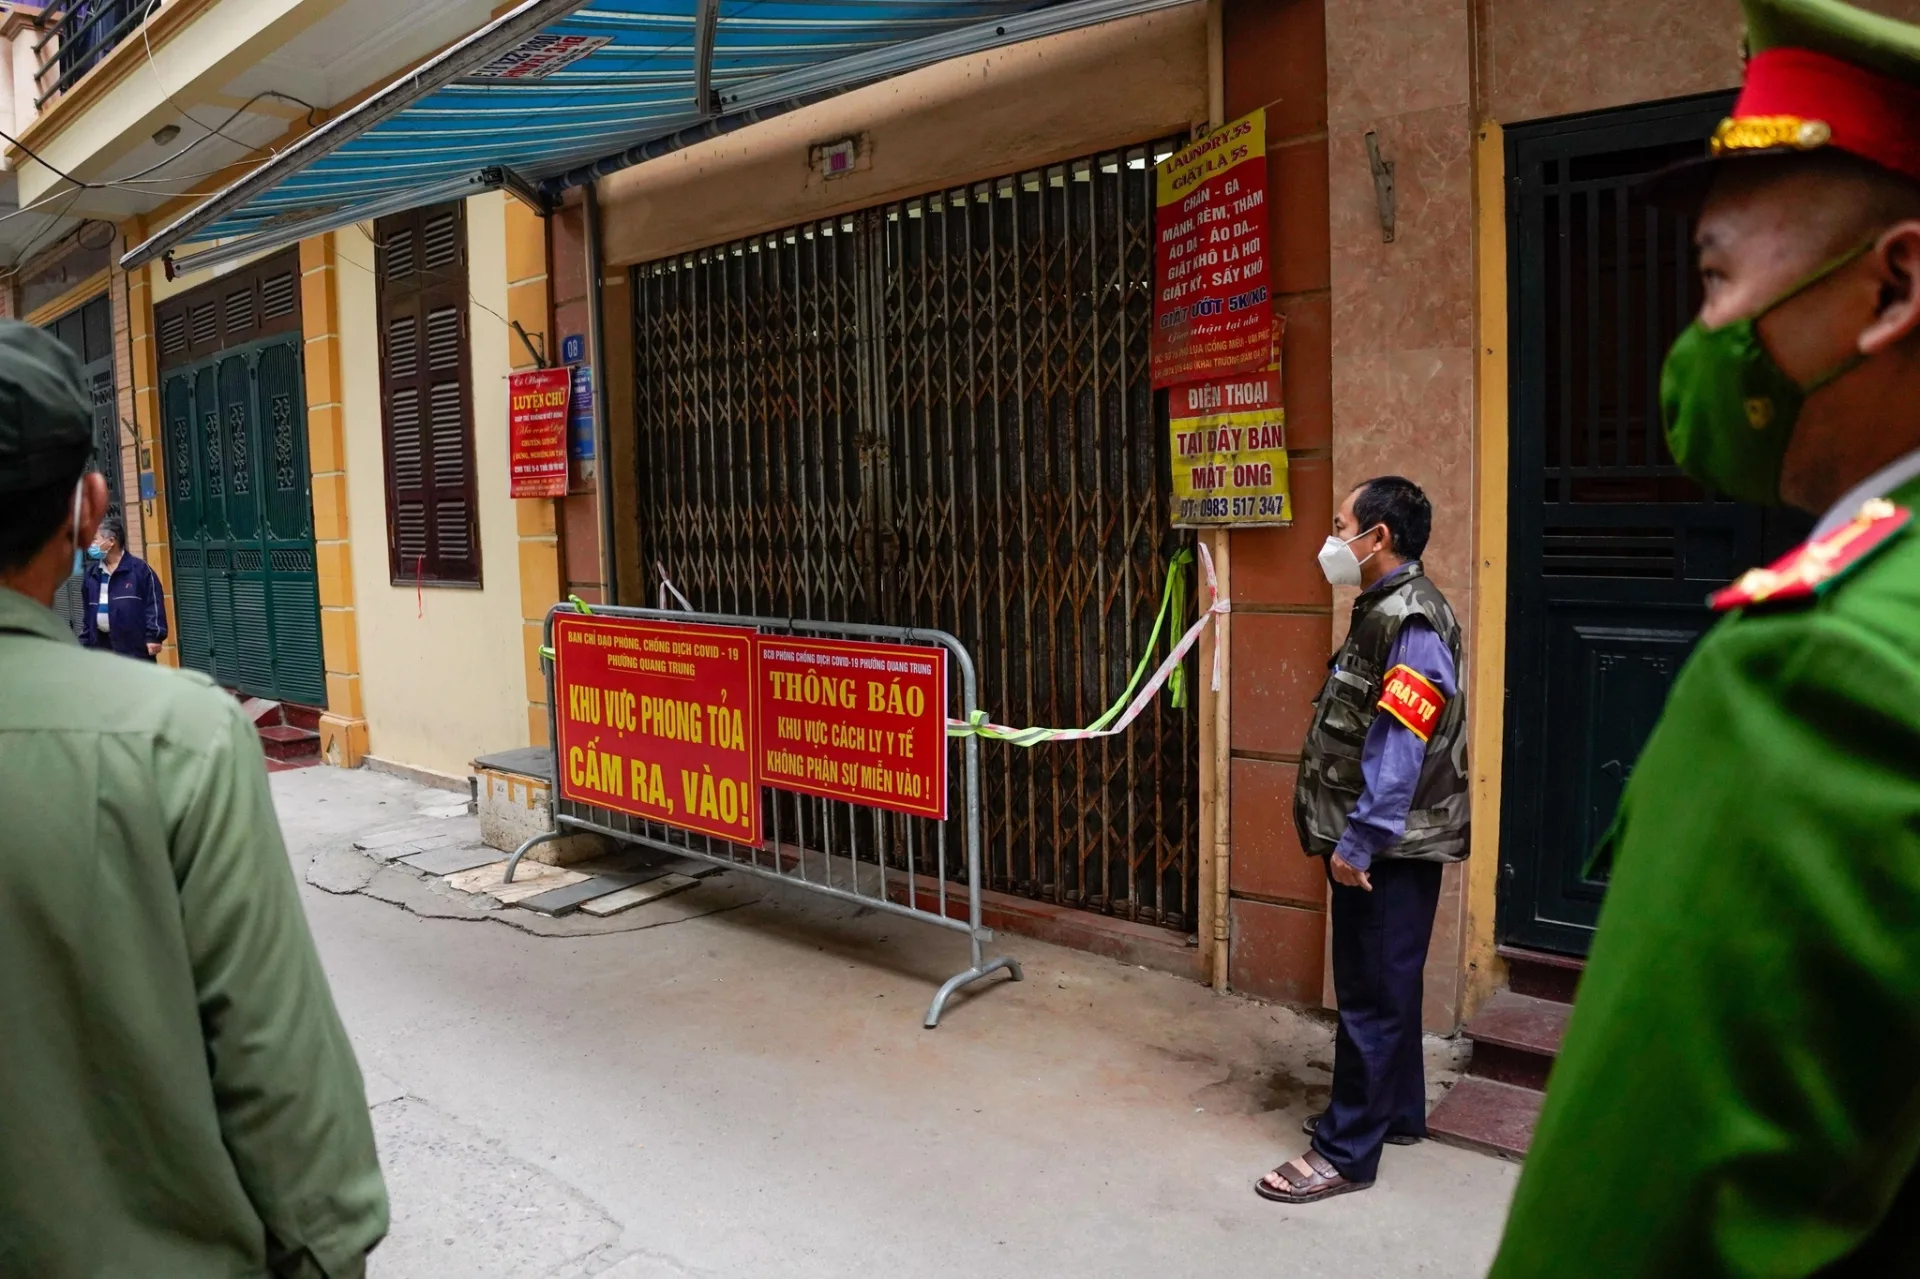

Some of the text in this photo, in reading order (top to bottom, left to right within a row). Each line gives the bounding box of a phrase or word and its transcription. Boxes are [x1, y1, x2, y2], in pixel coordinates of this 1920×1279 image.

[1231, 144, 1248, 162] 5S
[1225, 178, 1239, 196] GA
[1197, 205, 1230, 226] RÈM,
[1168, 237, 1260, 280] GIẶT KHÔ LÀ HƠI
[1169, 244, 1183, 260] ÁO
[1210, 226, 1230, 243] ÁO
[1163, 280, 1188, 301] GIẶT
[1211, 265, 1240, 286] SẤY
[1243, 256, 1263, 279] KHÔ
[1191, 296, 1224, 318] ƯỚT
[1190, 323, 1221, 336] nhận
[1226, 318, 1241, 331] tại
[567, 339, 578, 358] 08
[513, 390, 544, 412] LUYỆN
[545, 387, 566, 407] CHỮ
[1188, 381, 1268, 412] ĐIỆN THOẠI
[1176, 421, 1283, 458] TẠI ĐÂY BÁN
[1192, 462, 1272, 493] MẬT ONG
[1200, 498, 1228, 517] 0983
[1232, 497, 1256, 516] 517
[1259, 495, 1283, 515] 347
[567, 631, 582, 643] BAN
[584, 629, 596, 645] CHỈ
[597, 634, 612, 649] ĐẠO
[613, 634, 642, 651] PHÒNG,
[643, 636, 670, 654] CHỐNG
[672, 642, 692, 657] DỊCH
[694, 644, 719, 658] COVID
[728, 648, 738, 661] 19
[607, 653, 695, 676] PHƯỜNG QUANG TRUNG
[775, 649, 795, 662] PHÒNG
[795, 650, 815, 664] CHỐNG
[816, 654, 831, 667] DỊCH
[831, 655, 859, 668] COVID-19
[859, 657, 885, 670] PHƯỜNG
[886, 660, 908, 673] QUANG
[909, 663, 932, 675] TRUNG
[769, 668, 924, 717] THÔNG BÁO
[569, 684, 745, 751] KHU VỰC PHONG TỎA
[1417, 698, 1436, 723] TỰ
[778, 716, 914, 758] KHU VỰC CÁCH LY Y TẾ
[569, 736, 749, 828] CẤM RA, VÀO!
[767, 748, 804, 777] KHÔNG
[807, 754, 838, 787] PHẬN
[841, 762, 859, 792] SỰ
[861, 759, 892, 793] MIỄN
[896, 768, 921, 798] VÀO
